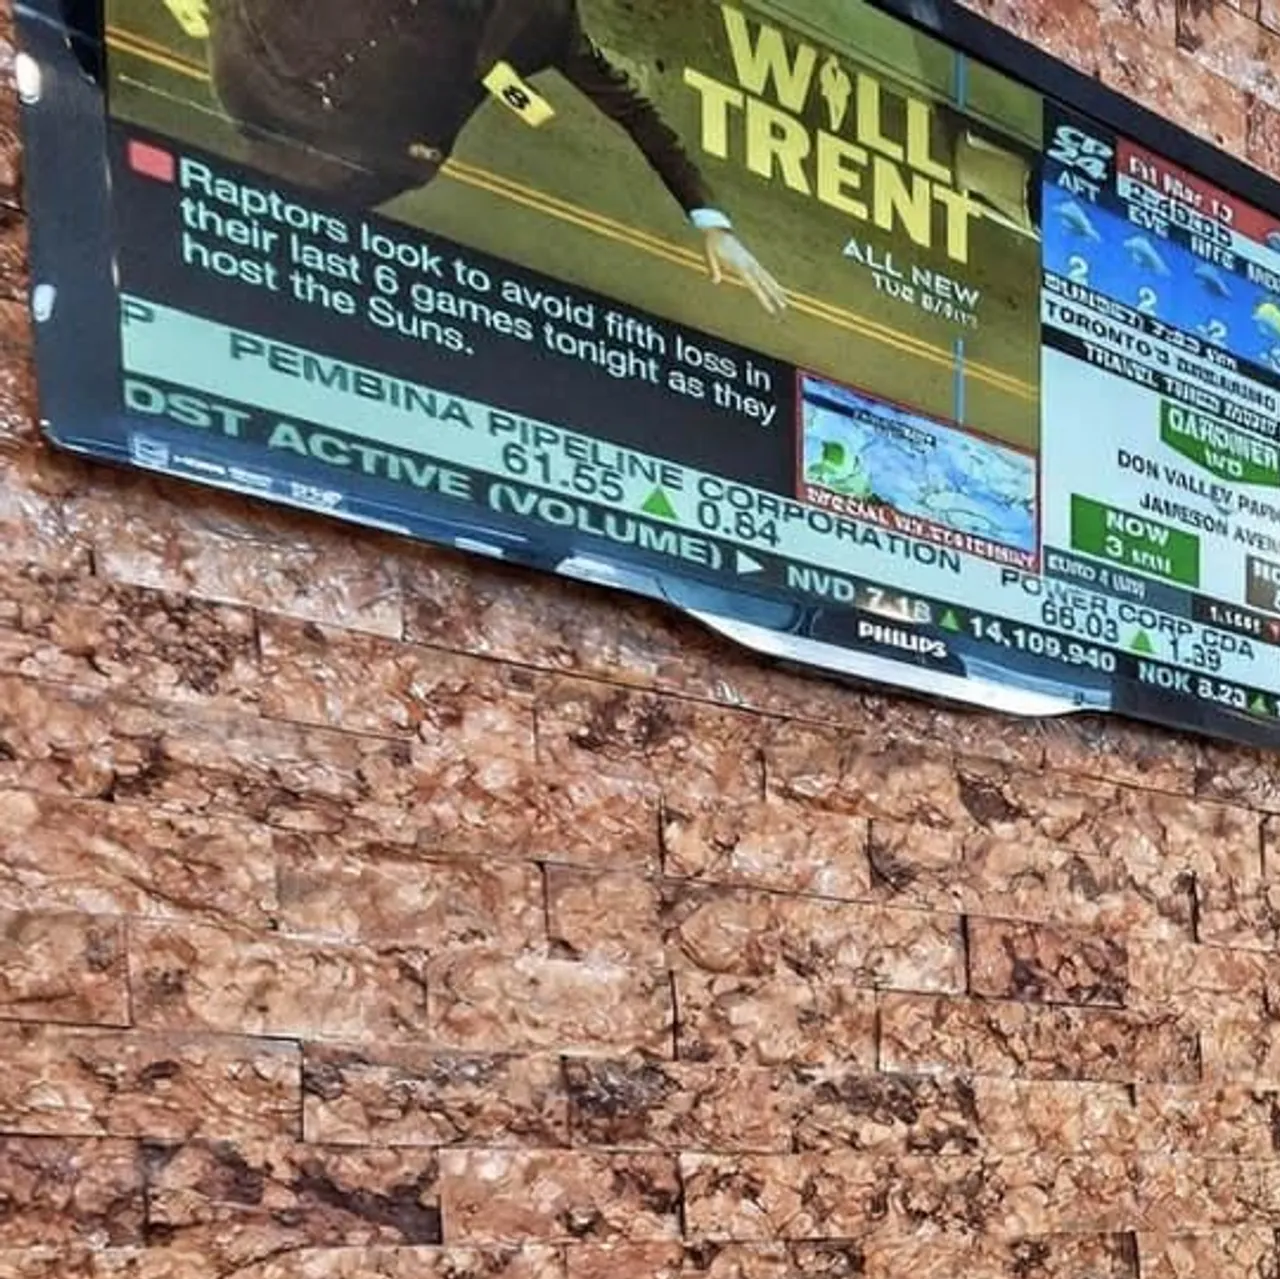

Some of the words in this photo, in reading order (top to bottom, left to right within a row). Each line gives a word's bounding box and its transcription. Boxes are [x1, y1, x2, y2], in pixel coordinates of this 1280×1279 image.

[720, 4, 951, 184] WILL
[683, 67, 983, 264] TRENT
[1047, 139, 1107, 180] 24
[1058, 170, 1100, 202] AFT
[179, 156, 349, 243] Raptors
[360, 222, 443, 278] look
[452, 258, 491, 291] to
[500, 280, 595, 331] avoid
[604, 311, 666, 355] fifth
[675, 334, 738, 379] loss
[745, 360, 772, 391] in
[181, 232, 279, 291] host
[288, 269, 356, 315] the
[367, 295, 475, 355] Suns.
[842, 237, 903, 279] ALL
[911, 265, 980, 308] NEW
[1068, 255, 1089, 286] 2
[1136, 286, 1157, 317] 2
[179, 197, 279, 253] their
[289, 232, 363, 285] last
[373, 264, 399, 295] 6
[409, 282, 534, 341] games
[543, 322, 661, 384] tonight
[667, 369, 705, 399] as
[712, 380, 777, 427] they
[1168, 407, 1280, 472] GARDINER
[229, 332, 475, 430] PEMBINA
[487, 409, 684, 492] PIPELINE
[697, 476, 962, 574] CORPORATION
[1000, 567, 1109, 616] POWER
[1118, 603, 1195, 637] CORP
[1201, 628, 1256, 661] CDA
[502, 442, 624, 504] 61.55
[697, 501, 782, 547] 0.84
[1117, 448, 1160, 481] DON
[1162, 464, 1234, 505] VALLEY
[1104, 535, 1124, 558] 3
[1106, 510, 1170, 549] NOW
[1139, 492, 1228, 537] JAMESON
[267, 421, 473, 500] ACTIVE
[487, 480, 724, 571] (VOLUME)
[786, 564, 856, 601] NVD
[1137, 660, 1192, 694] NOK
[857, 620, 948, 659] PHILIPS
